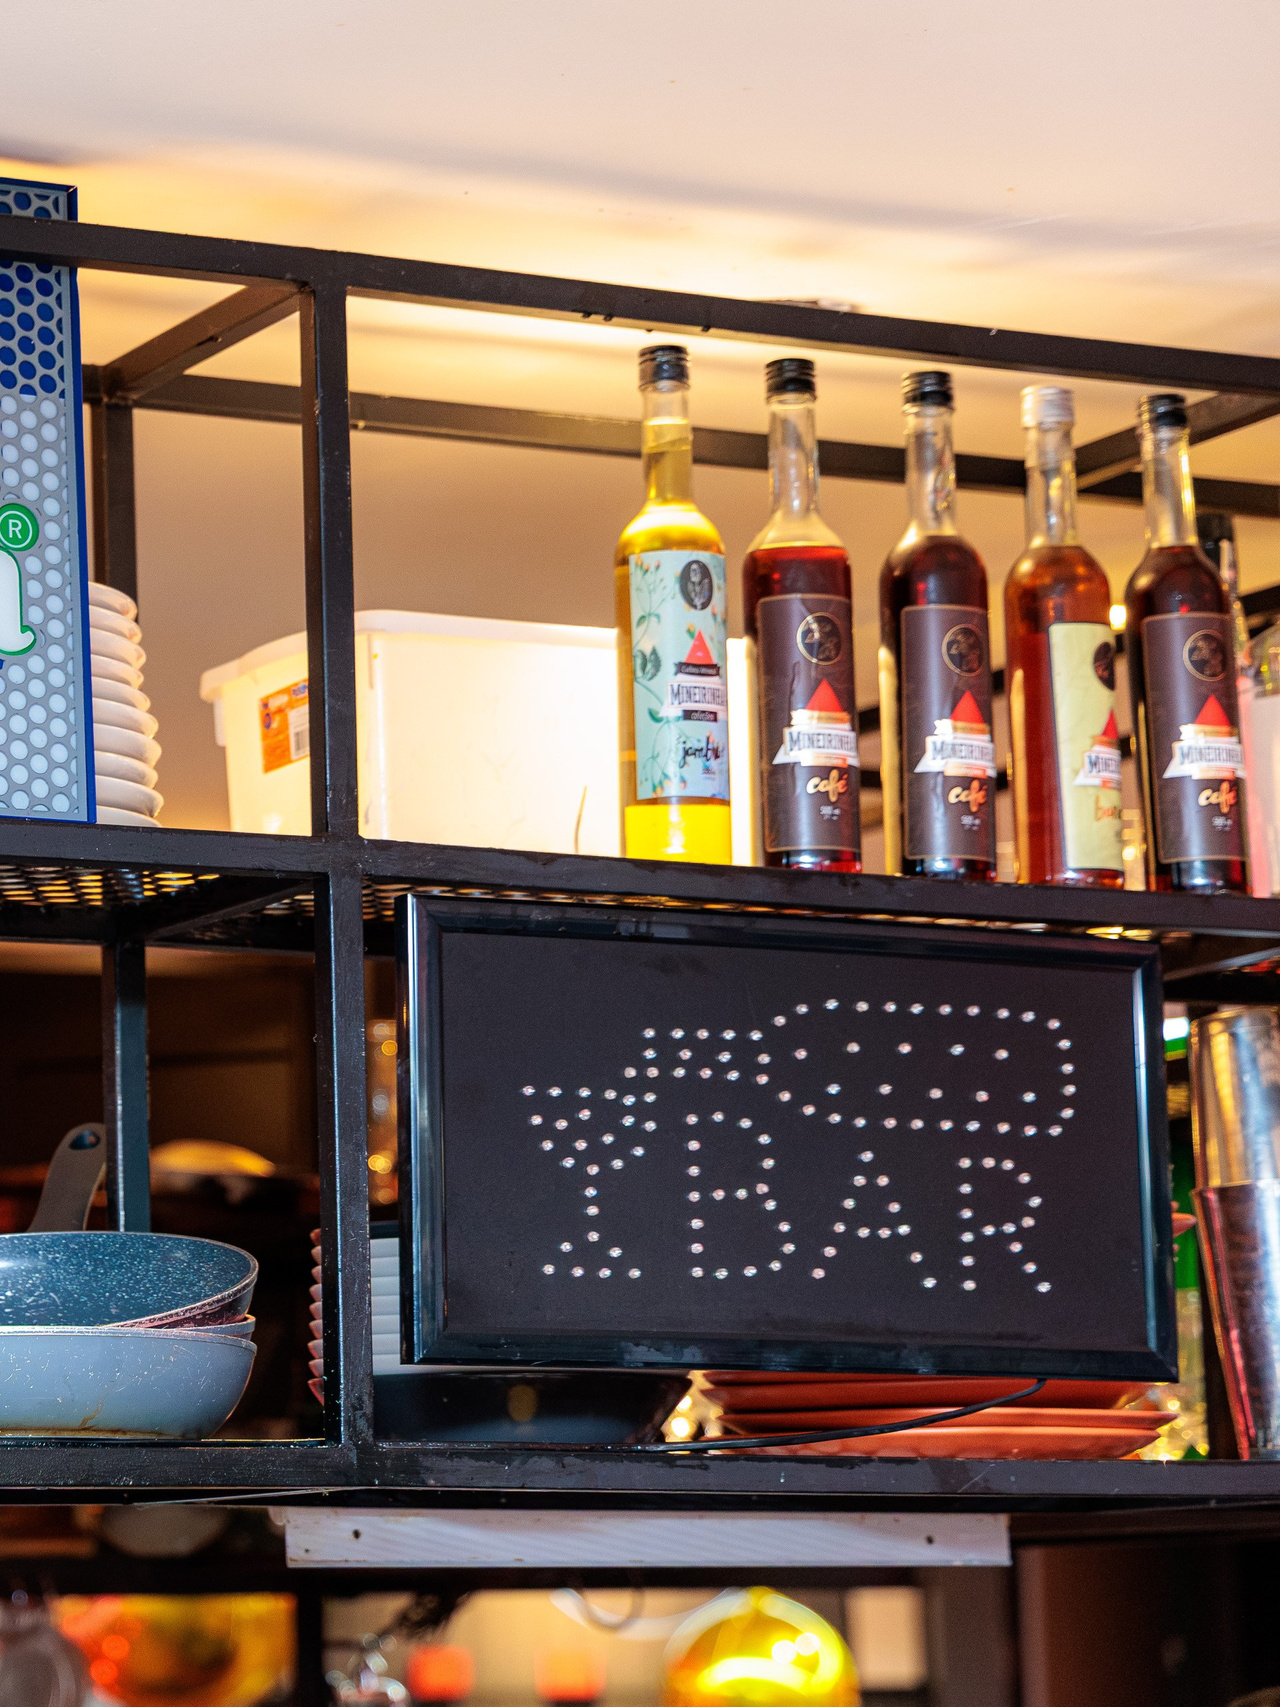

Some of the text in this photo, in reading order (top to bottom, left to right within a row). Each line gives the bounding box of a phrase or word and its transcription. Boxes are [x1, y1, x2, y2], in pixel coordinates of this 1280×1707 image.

[806, 769, 849, 803] café
[948, 779, 988, 812] café
[1198, 780, 1237, 814] café
[685, 1110, 1053, 1295] BAR
